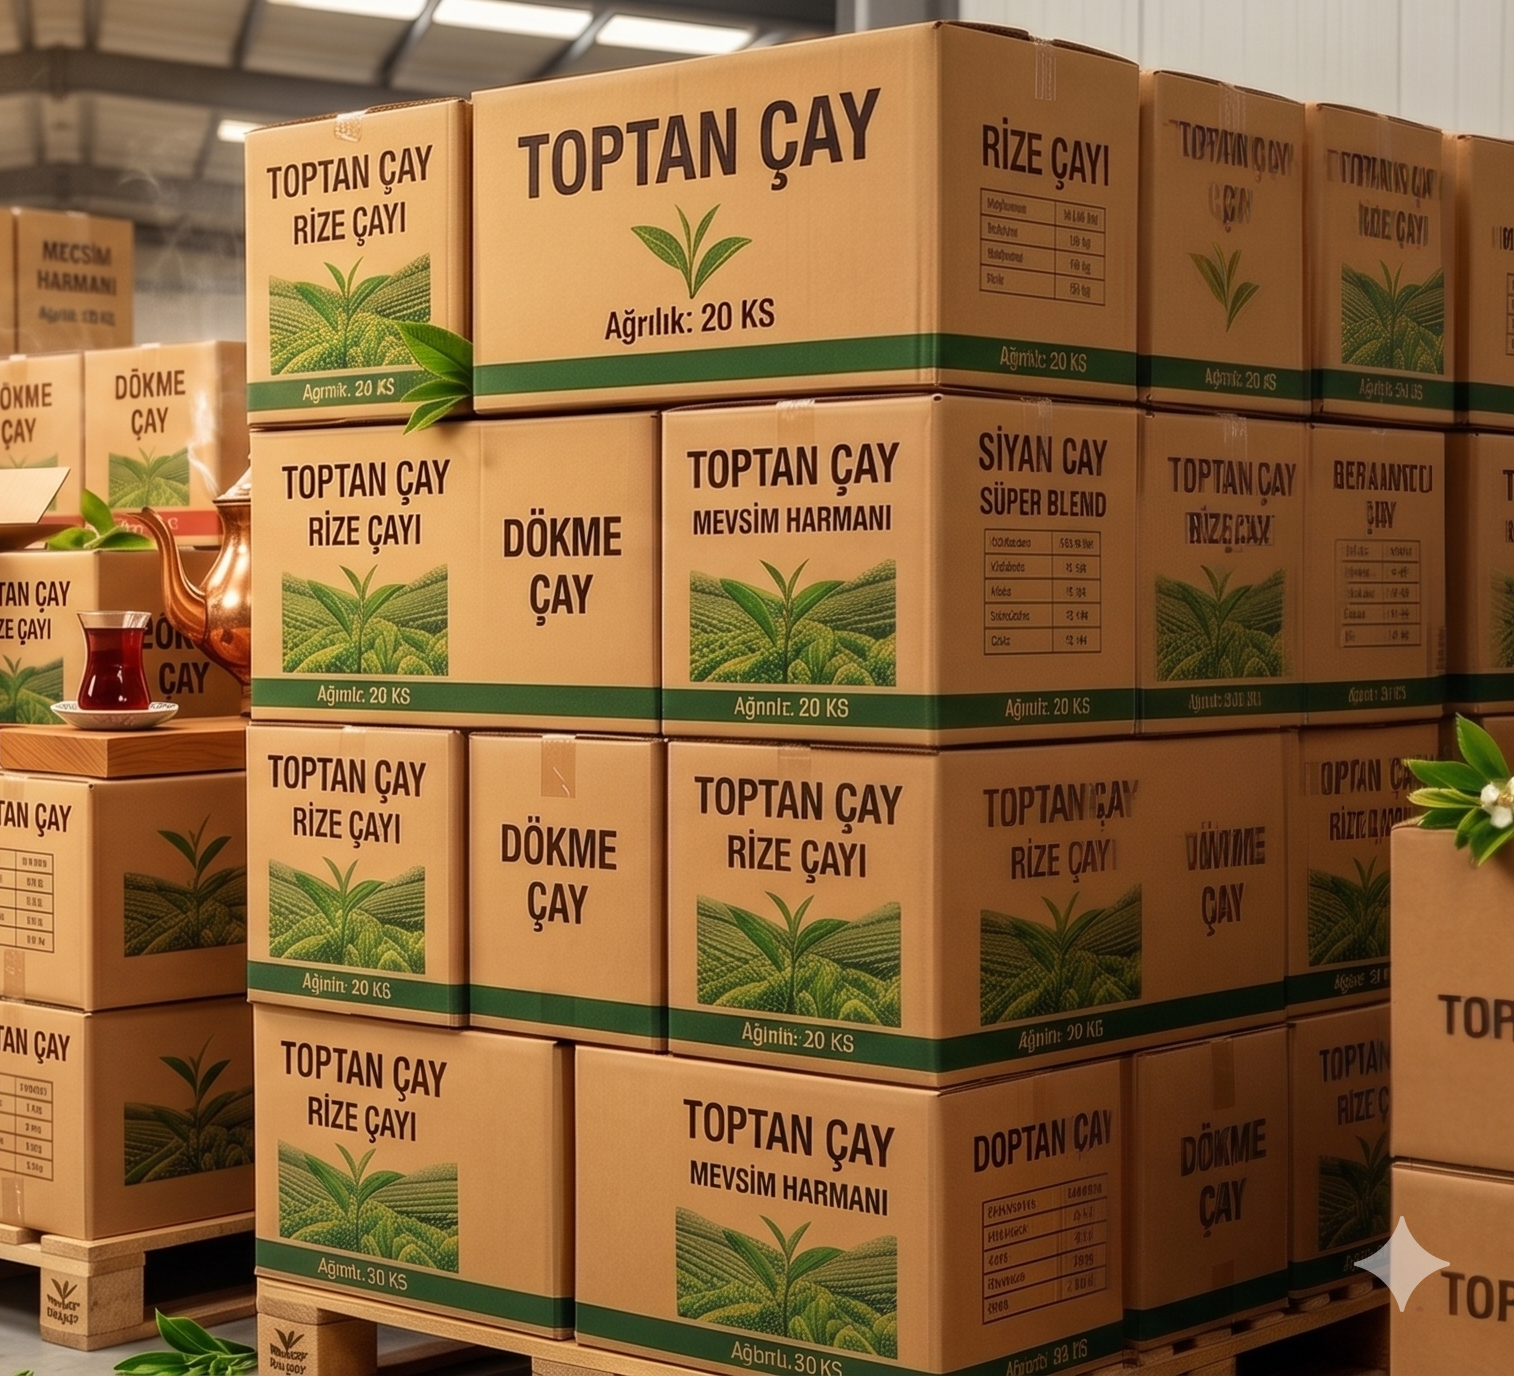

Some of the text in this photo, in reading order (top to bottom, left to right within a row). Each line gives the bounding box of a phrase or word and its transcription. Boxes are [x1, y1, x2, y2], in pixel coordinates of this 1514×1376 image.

[518, 87, 881, 199] TOPTAN ÇAY
[982, 117, 1109, 191] RİZE ÇAYI
[267, 144, 433, 200] TOPTAN ÇAY
[293, 201, 406, 248] RİZE ÇAYI
[36, 270, 118, 297] HARMANI
[605, 298, 775, 346] Ağrılık: 20 KS
[114, 366, 187, 400] DÖKME
[1050, 352, 1067, 370] 20
[1070, 353, 1087, 372] KS
[1245, 371, 1261, 389] 20
[354, 380, 373, 397] 20
[0, 417, 37, 450] ÇAY
[130, 407, 169, 441] ÇAY
[687, 442, 900, 496] TOPTAN ÇAY
[978, 426, 1052, 475] SİYAN
[282, 459, 451, 504] TOPTAN ÇAY
[980, 481, 1107, 518] SÜPER BLEND
[308, 511, 422, 555] RİZE ÇAYI
[504, 508, 622, 559] DÖKME
[692, 501, 892, 537] MEVSİM HARMANI
[34, 580, 71, 615] ÇAY
[529, 574, 594, 626] ÇAY
[17, 617, 52, 647] ÇAYI
[158, 661, 210, 701] ÇAY
[369, 687, 387, 704] 20
[392, 687, 411, 704] KS
[799, 698, 820, 718] 20
[826, 698, 849, 718] KS
[1053, 698, 1069, 714] 20
[1072, 698, 1091, 714] KS
[268, 755, 427, 805] TOPTAN ÇAY
[34, 802, 72, 838] ÇAY
[293, 802, 401, 848] RİZE ÇAYI
[694, 777, 903, 835] TOPTAN ÇAY
[983, 784, 1086, 828] TOPTAN
[500, 816, 617, 871] DÖKME
[727, 829, 867, 884] RİZE ÇAYI
[1010, 838, 1061, 880] RİZE
[527, 881, 589, 932] ÇAY
[351, 979, 369, 995] 20
[34, 1030, 71, 1065] ÇAY
[803, 1030, 825, 1049] 20
[831, 1033, 855, 1053] KS
[281, 1040, 447, 1102] TOPTAN ÇAY
[307, 1092, 417, 1144] RİZE ÇAYI
[684, 1098, 894, 1172] TOPTAN ÇAY
[974, 1118, 1066, 1173] DOPTAN
[1180, 1117, 1267, 1177] DÖKME
[690, 1159, 888, 1217] MEVSİM HARMANI
[1199, 1178, 1247, 1239] ÇAY
[367, 1267, 385, 1285] 30
[388, 1272, 408, 1291] KS
[794, 1353, 817, 1373] 30
[820, 1358, 843, 1376] KS
